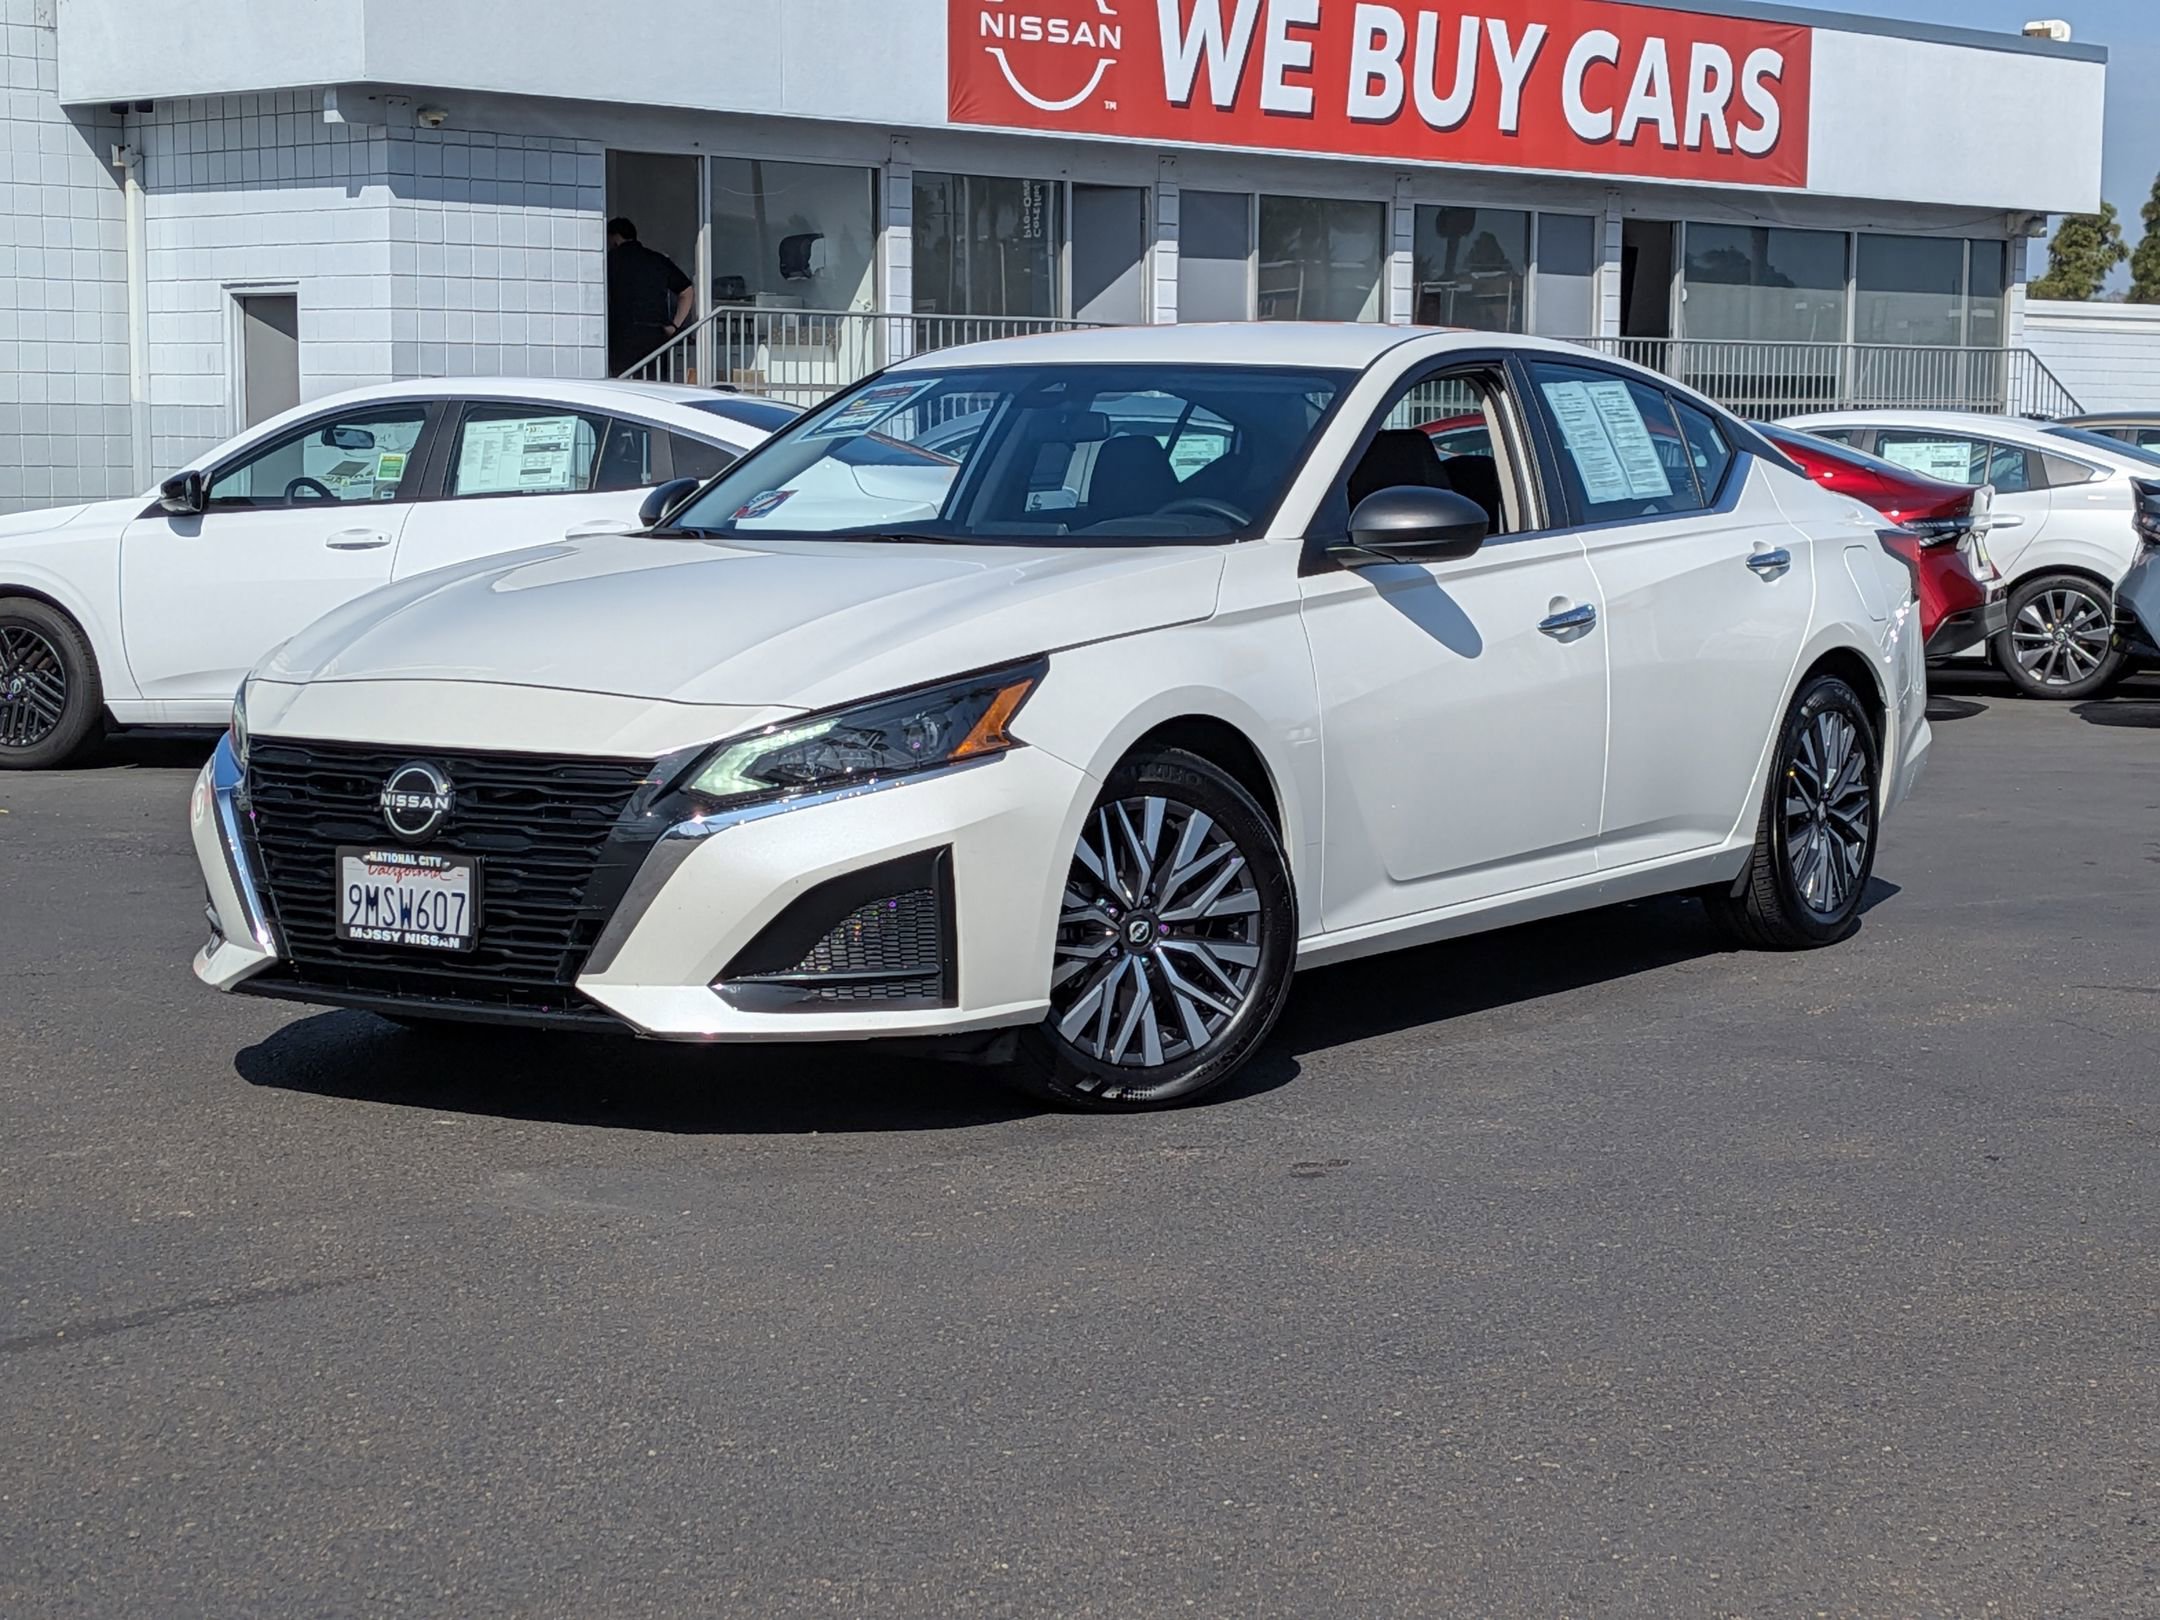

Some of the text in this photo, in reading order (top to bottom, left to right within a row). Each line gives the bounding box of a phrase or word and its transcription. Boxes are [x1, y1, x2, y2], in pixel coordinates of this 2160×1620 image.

[980, 11, 1121, 50] NISSAN
[1156, 0, 1784, 155] WE BUY CARS
[380, 792, 449, 809] NISSAN
[369, 851, 442, 867] NATIONAL CITY
[349, 884, 466, 934] 9MSW607
[350, 926, 460, 949] MOSSY NISSAN
